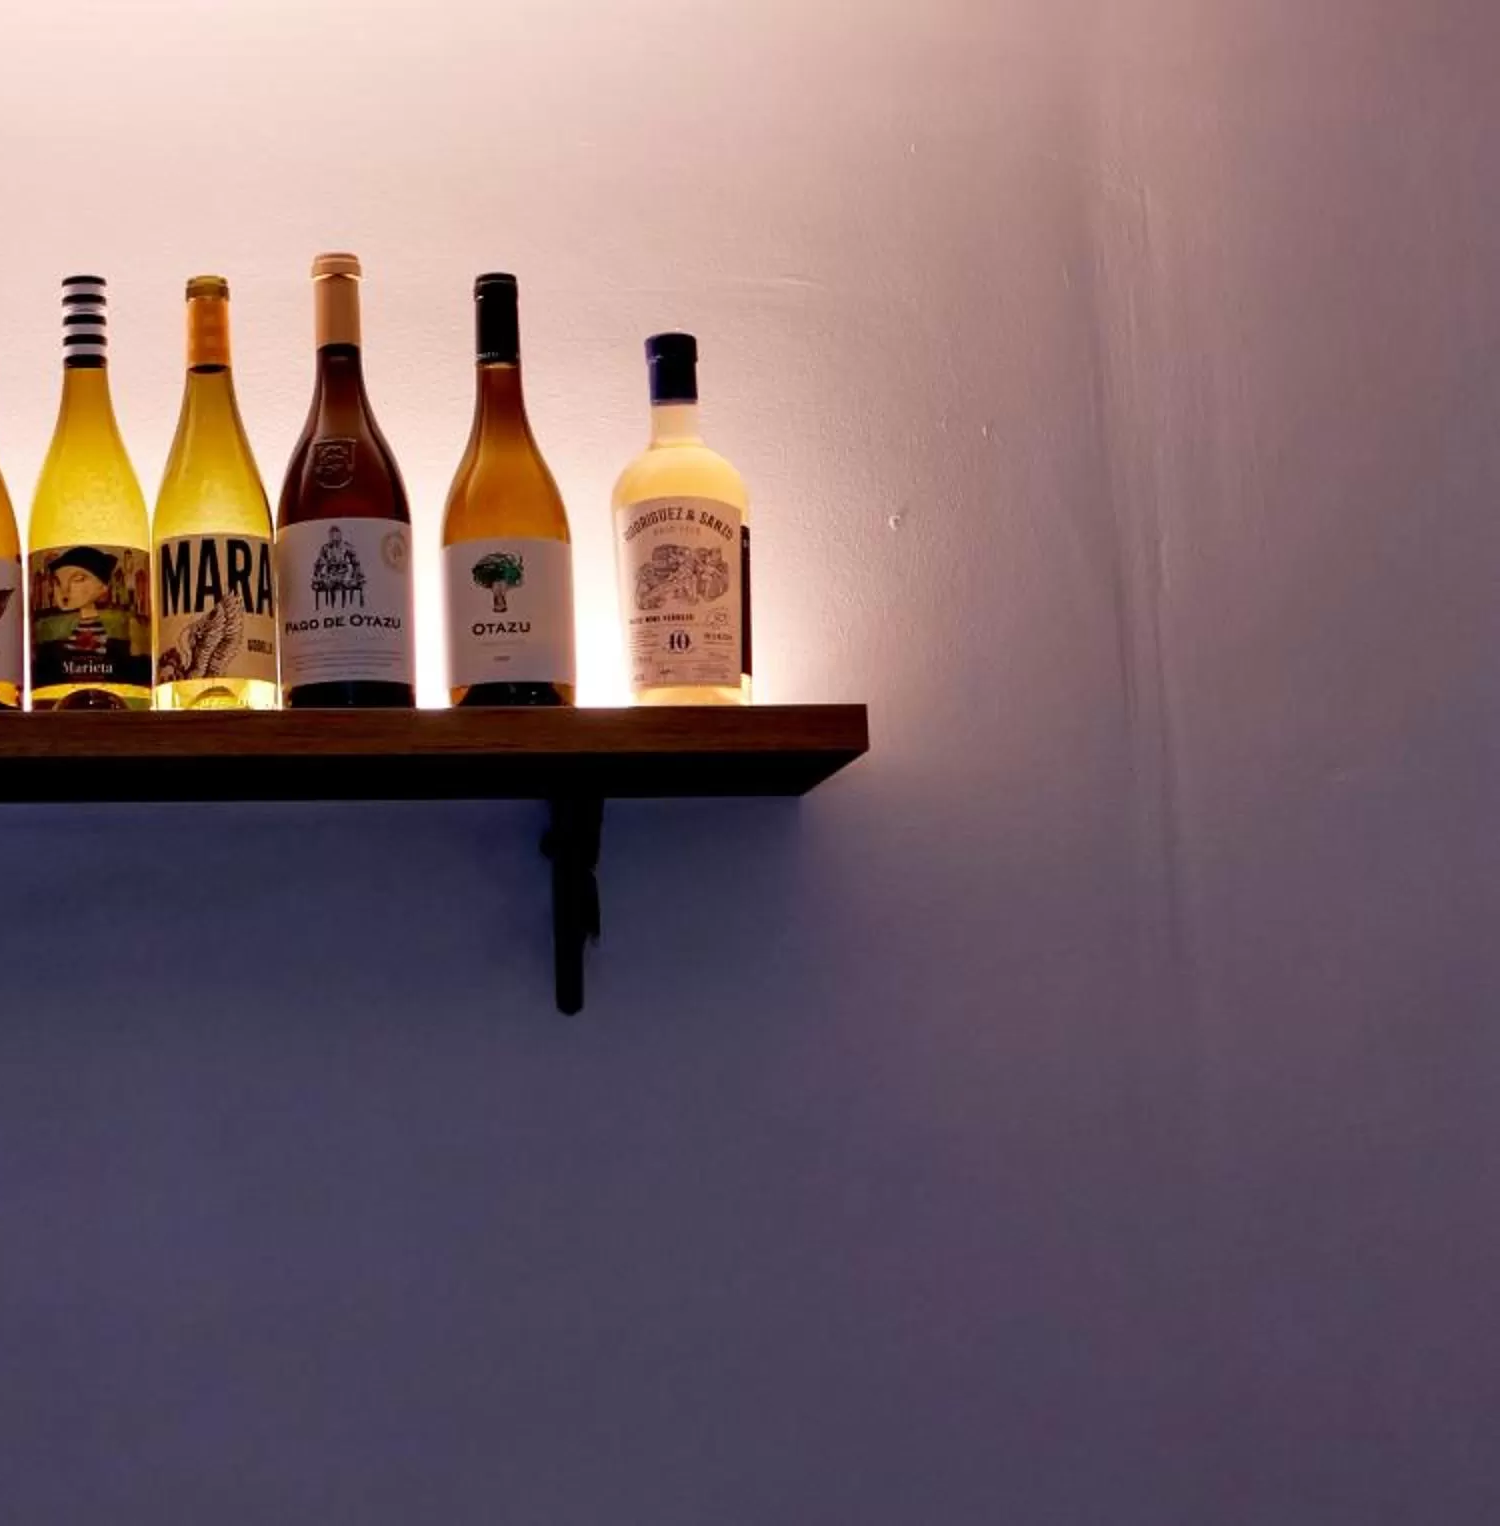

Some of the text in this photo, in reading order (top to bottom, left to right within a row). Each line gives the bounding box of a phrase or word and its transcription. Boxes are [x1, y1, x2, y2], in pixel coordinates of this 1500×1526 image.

[685, 509, 695, 521] &
[161, 538, 273, 617] MARA
[285, 613, 401, 635] PAGO DE OTAZU
[471, 621, 531, 636] OTAZU
[668, 632, 690, 650] 10
[62, 660, 113, 674] Marieta
